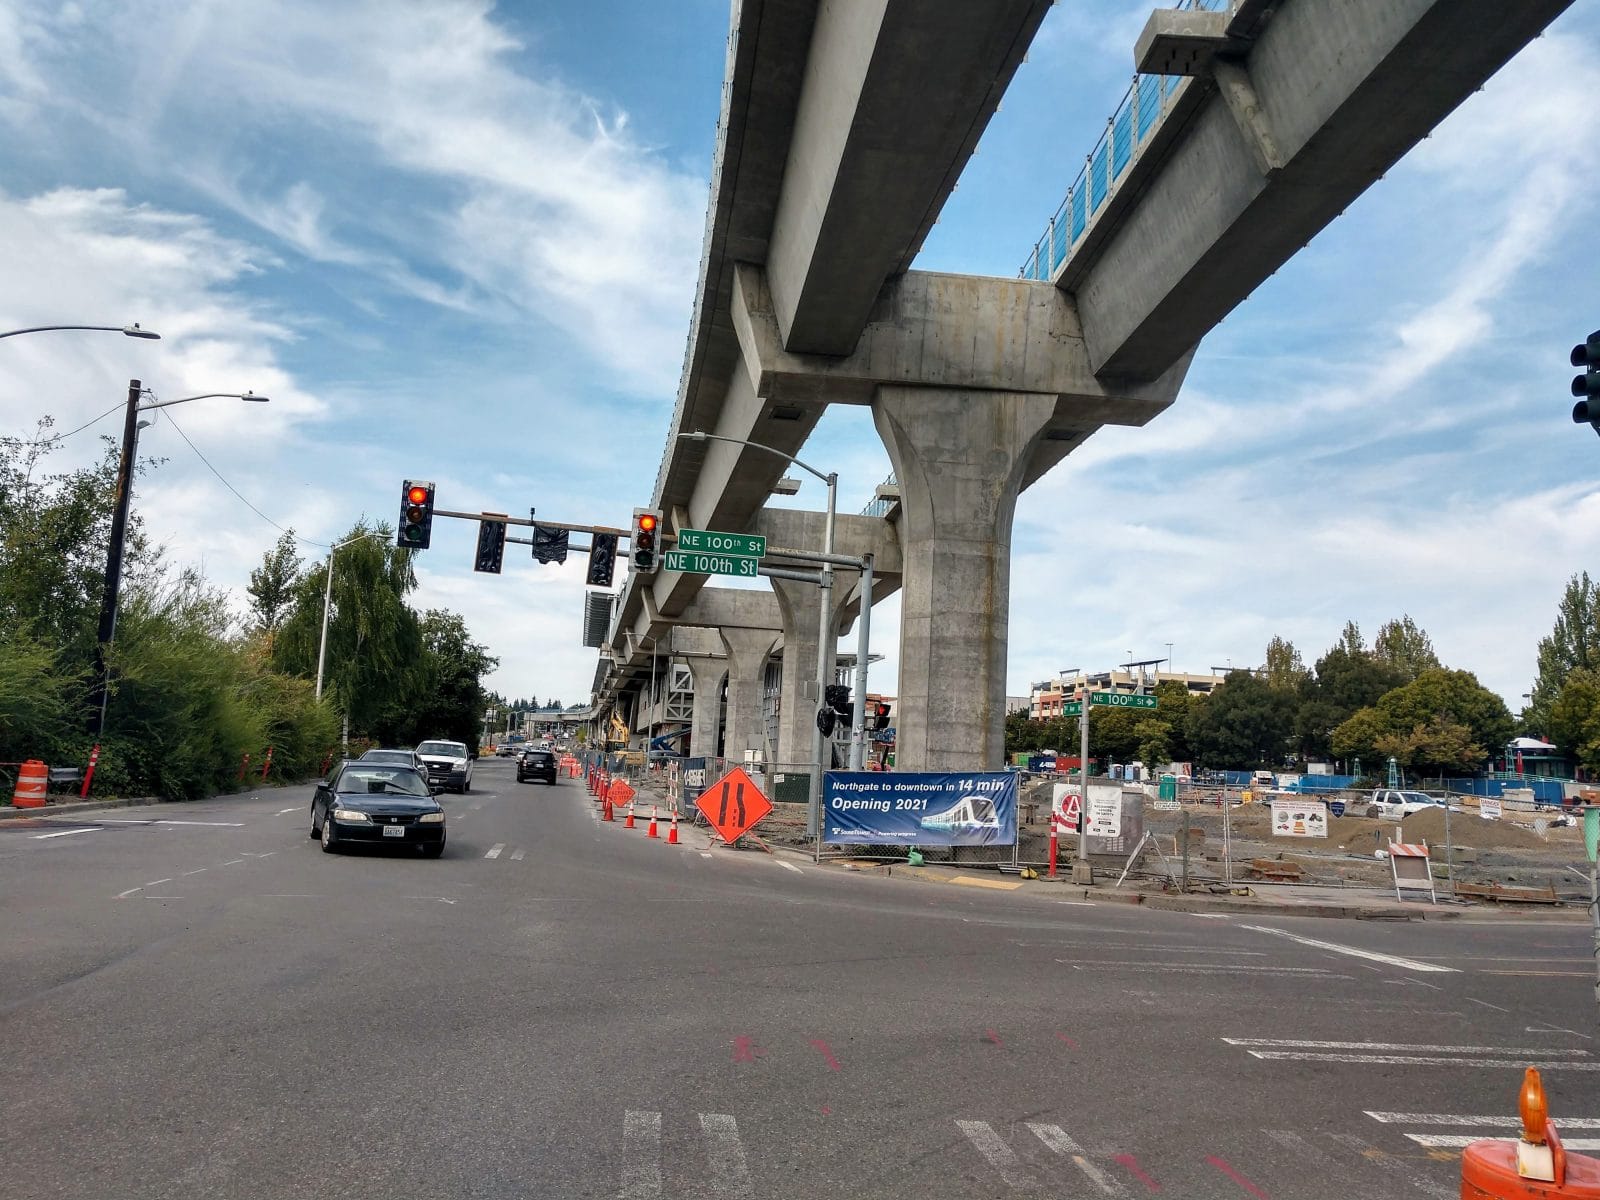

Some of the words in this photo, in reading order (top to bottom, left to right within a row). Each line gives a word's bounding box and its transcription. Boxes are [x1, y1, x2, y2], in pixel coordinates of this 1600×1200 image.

[682, 535, 700, 546] NE
[706, 536, 742, 550] 100th
[748, 541, 761, 552] St
[668, 554, 687, 570] NE
[694, 556, 733, 573] 100th
[740, 560, 754, 575] St
[1093, 694, 1104, 702] NE
[1108, 695, 1134, 706] 100th
[1136, 698, 1144, 706] St
[832, 782, 880, 792] Northgate
[882, 783, 892, 791] to
[894, 782, 943, 792] downtown
[945, 783, 955, 791] in
[958, 779, 973, 791] 14
[976, 779, 1005, 791] min
[831, 797, 891, 813] Opening
[895, 798, 928, 811] 2021
